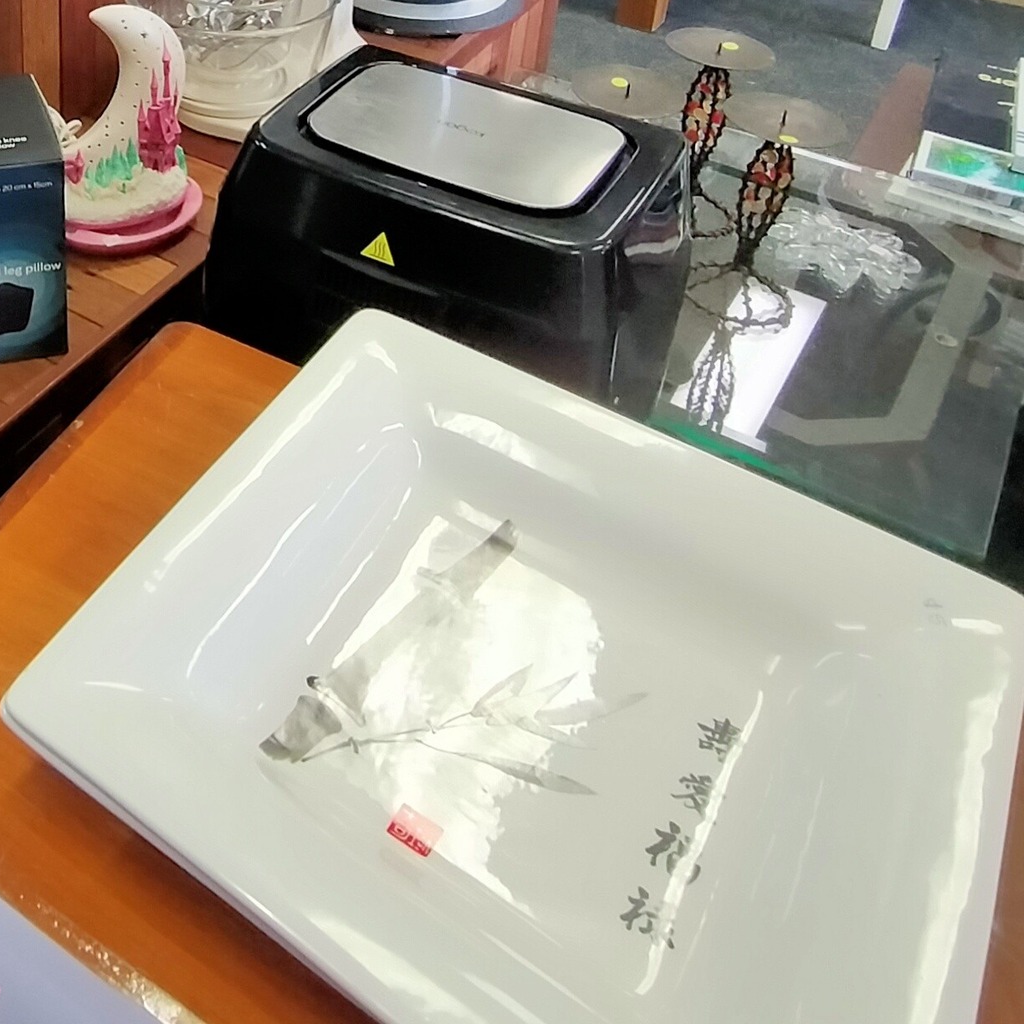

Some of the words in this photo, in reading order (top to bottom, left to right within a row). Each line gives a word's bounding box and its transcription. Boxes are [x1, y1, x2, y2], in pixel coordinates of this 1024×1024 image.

[2, 136, 28, 144] knee
[4, 265, 23, 278] leg
[25, 261, 62, 275] pillow
